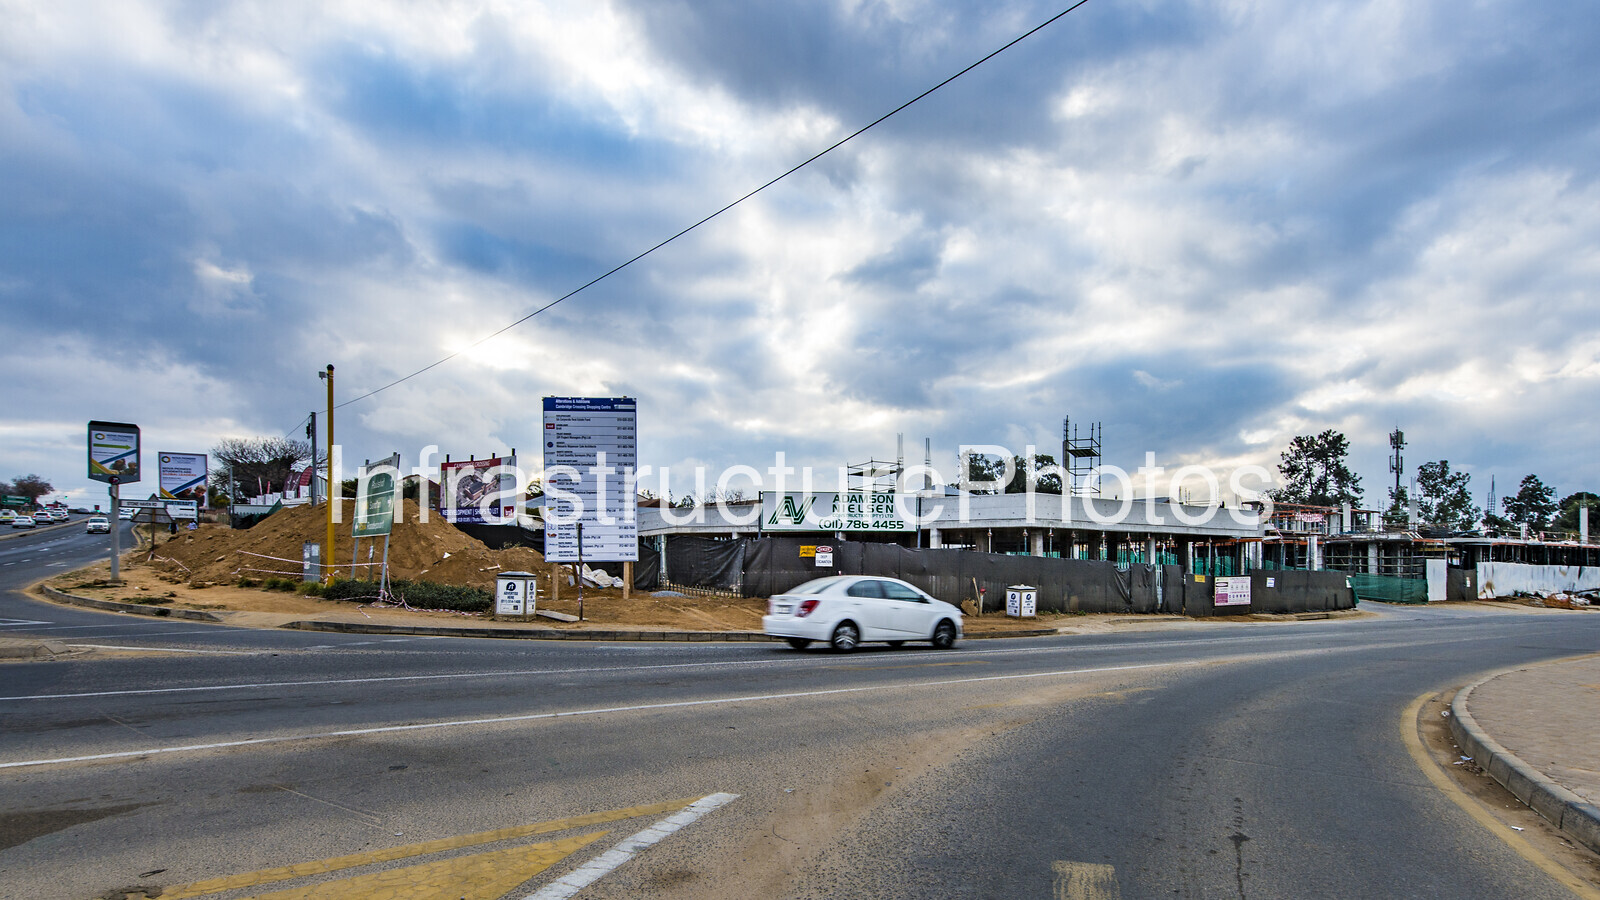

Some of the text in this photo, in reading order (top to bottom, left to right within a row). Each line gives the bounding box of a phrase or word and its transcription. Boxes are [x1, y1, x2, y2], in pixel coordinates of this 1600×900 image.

[832, 494, 894, 504] ADAMSON
[832, 504, 894, 513] NIELSEN
[846, 520, 869, 529] 786
[872, 520, 904, 529] 4455
